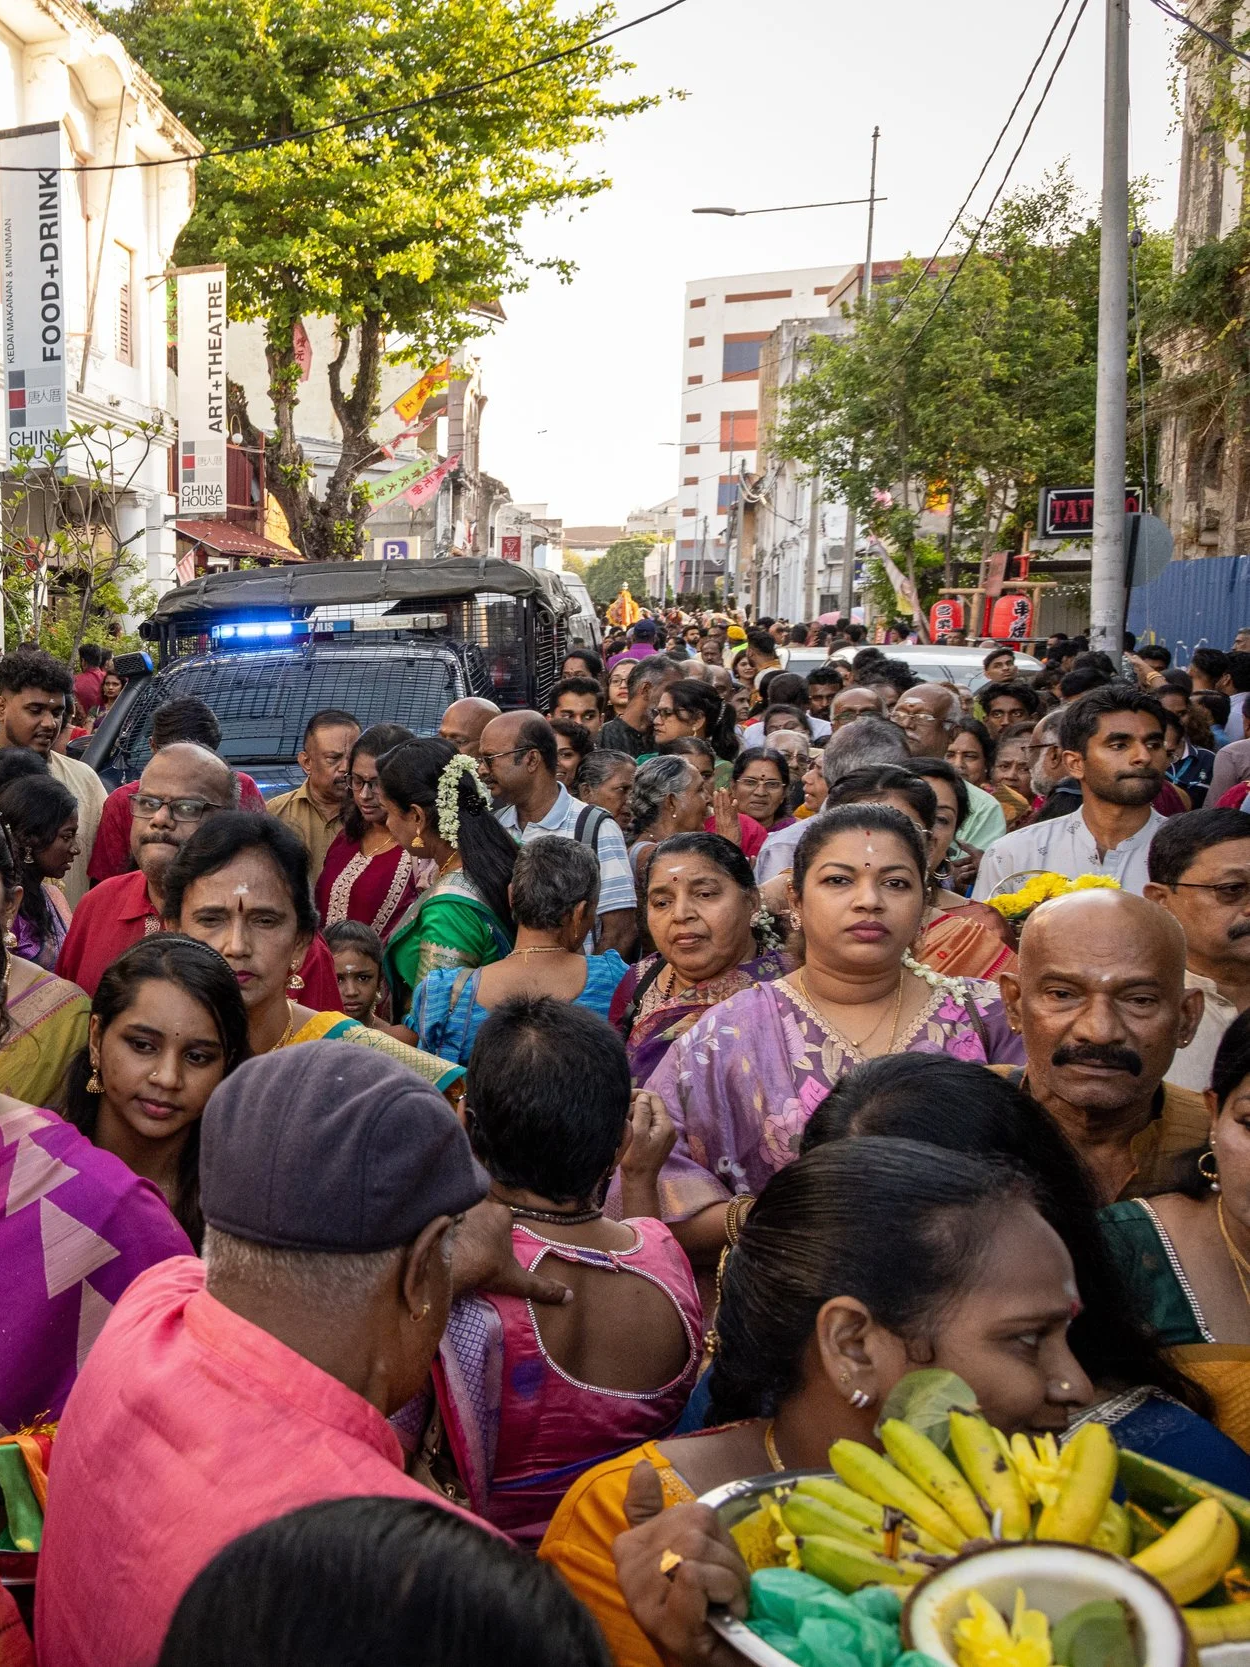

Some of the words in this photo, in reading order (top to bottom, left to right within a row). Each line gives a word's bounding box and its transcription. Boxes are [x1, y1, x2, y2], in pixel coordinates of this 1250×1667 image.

[4, 218, 13, 267] MINUMAN
[38, 168, 62, 362] FOOD+DRINK
[5, 281, 14, 331] MAKANAN
[6, 333, 15, 364] KEDAI
[208, 281, 222, 433] ART+THEATRE
[9, 443, 61, 461] HUE
[181, 484, 223, 496] CHINA
[181, 495, 223, 506] HOUSE
[1051, 496, 1139, 524] TATO
